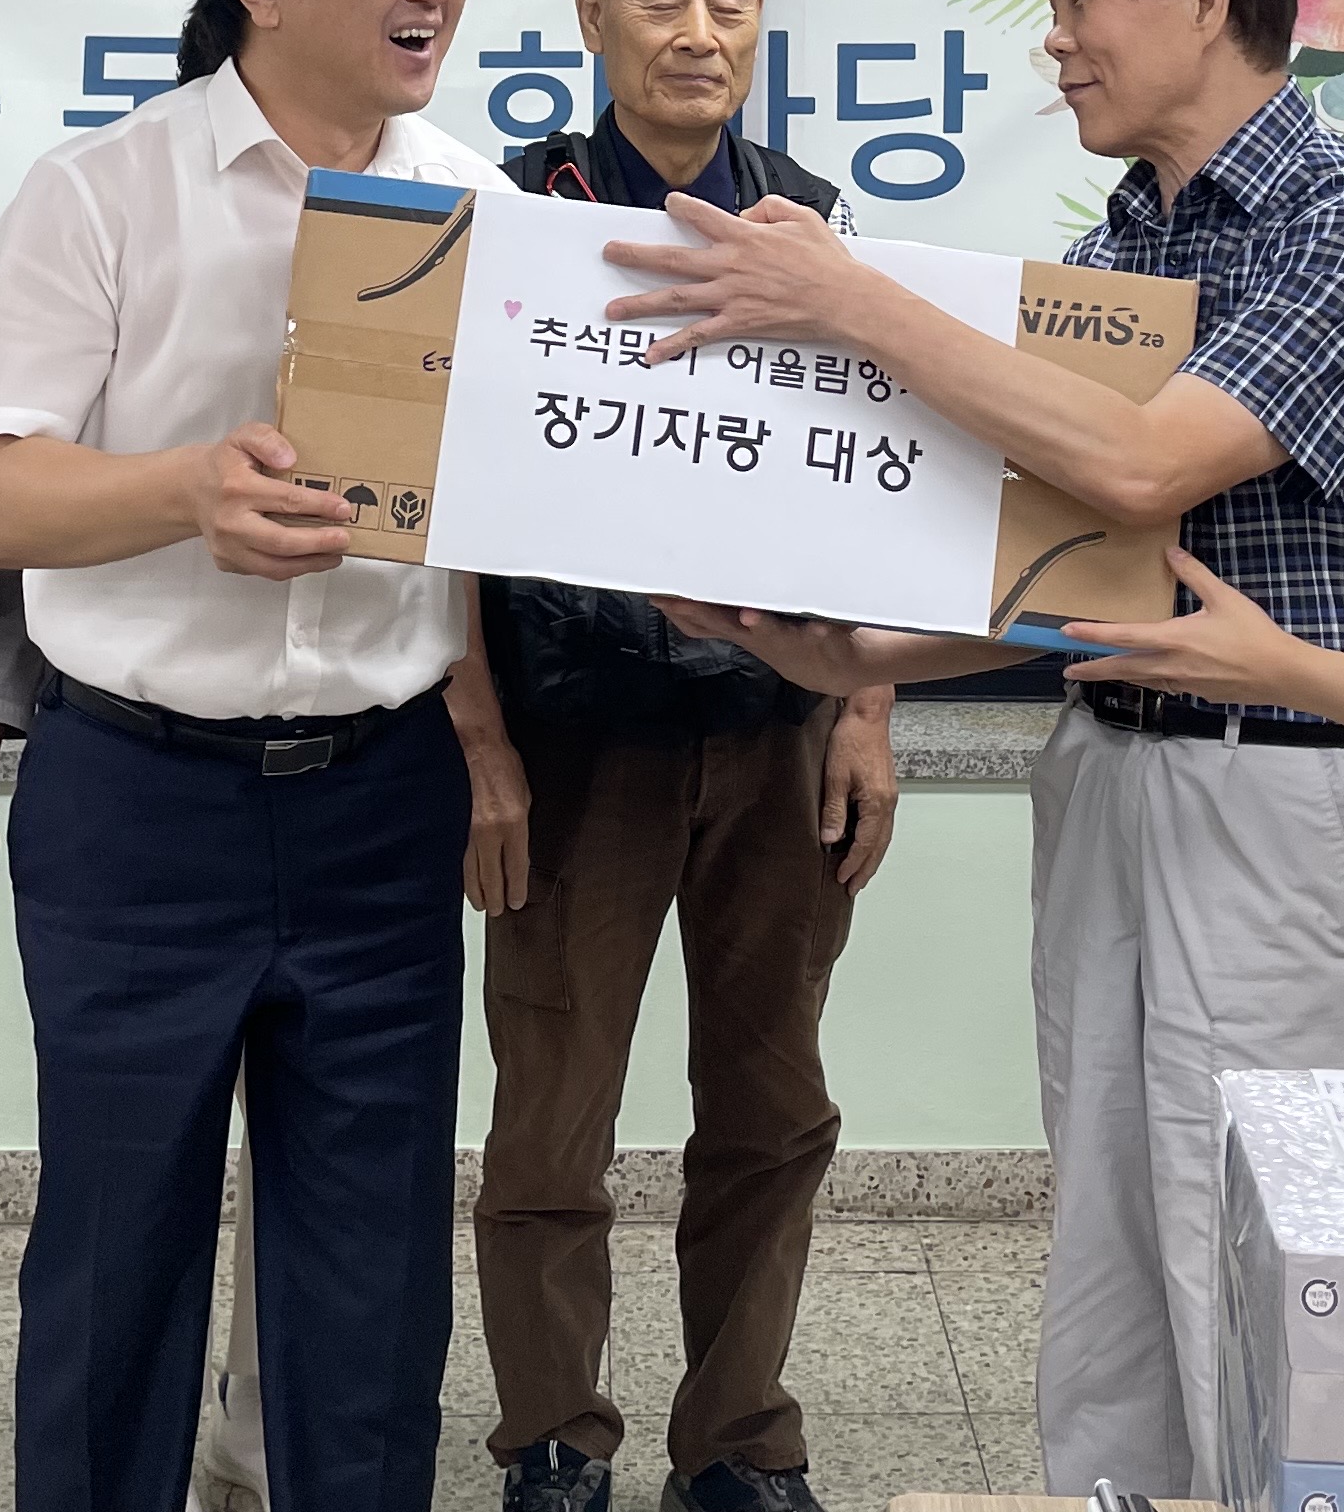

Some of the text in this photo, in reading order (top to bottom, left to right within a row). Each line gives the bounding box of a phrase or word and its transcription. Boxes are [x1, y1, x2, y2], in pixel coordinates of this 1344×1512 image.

[727, 342, 908, 403] 어울림행
[535, 391, 923, 493] 장기자랑 대상
